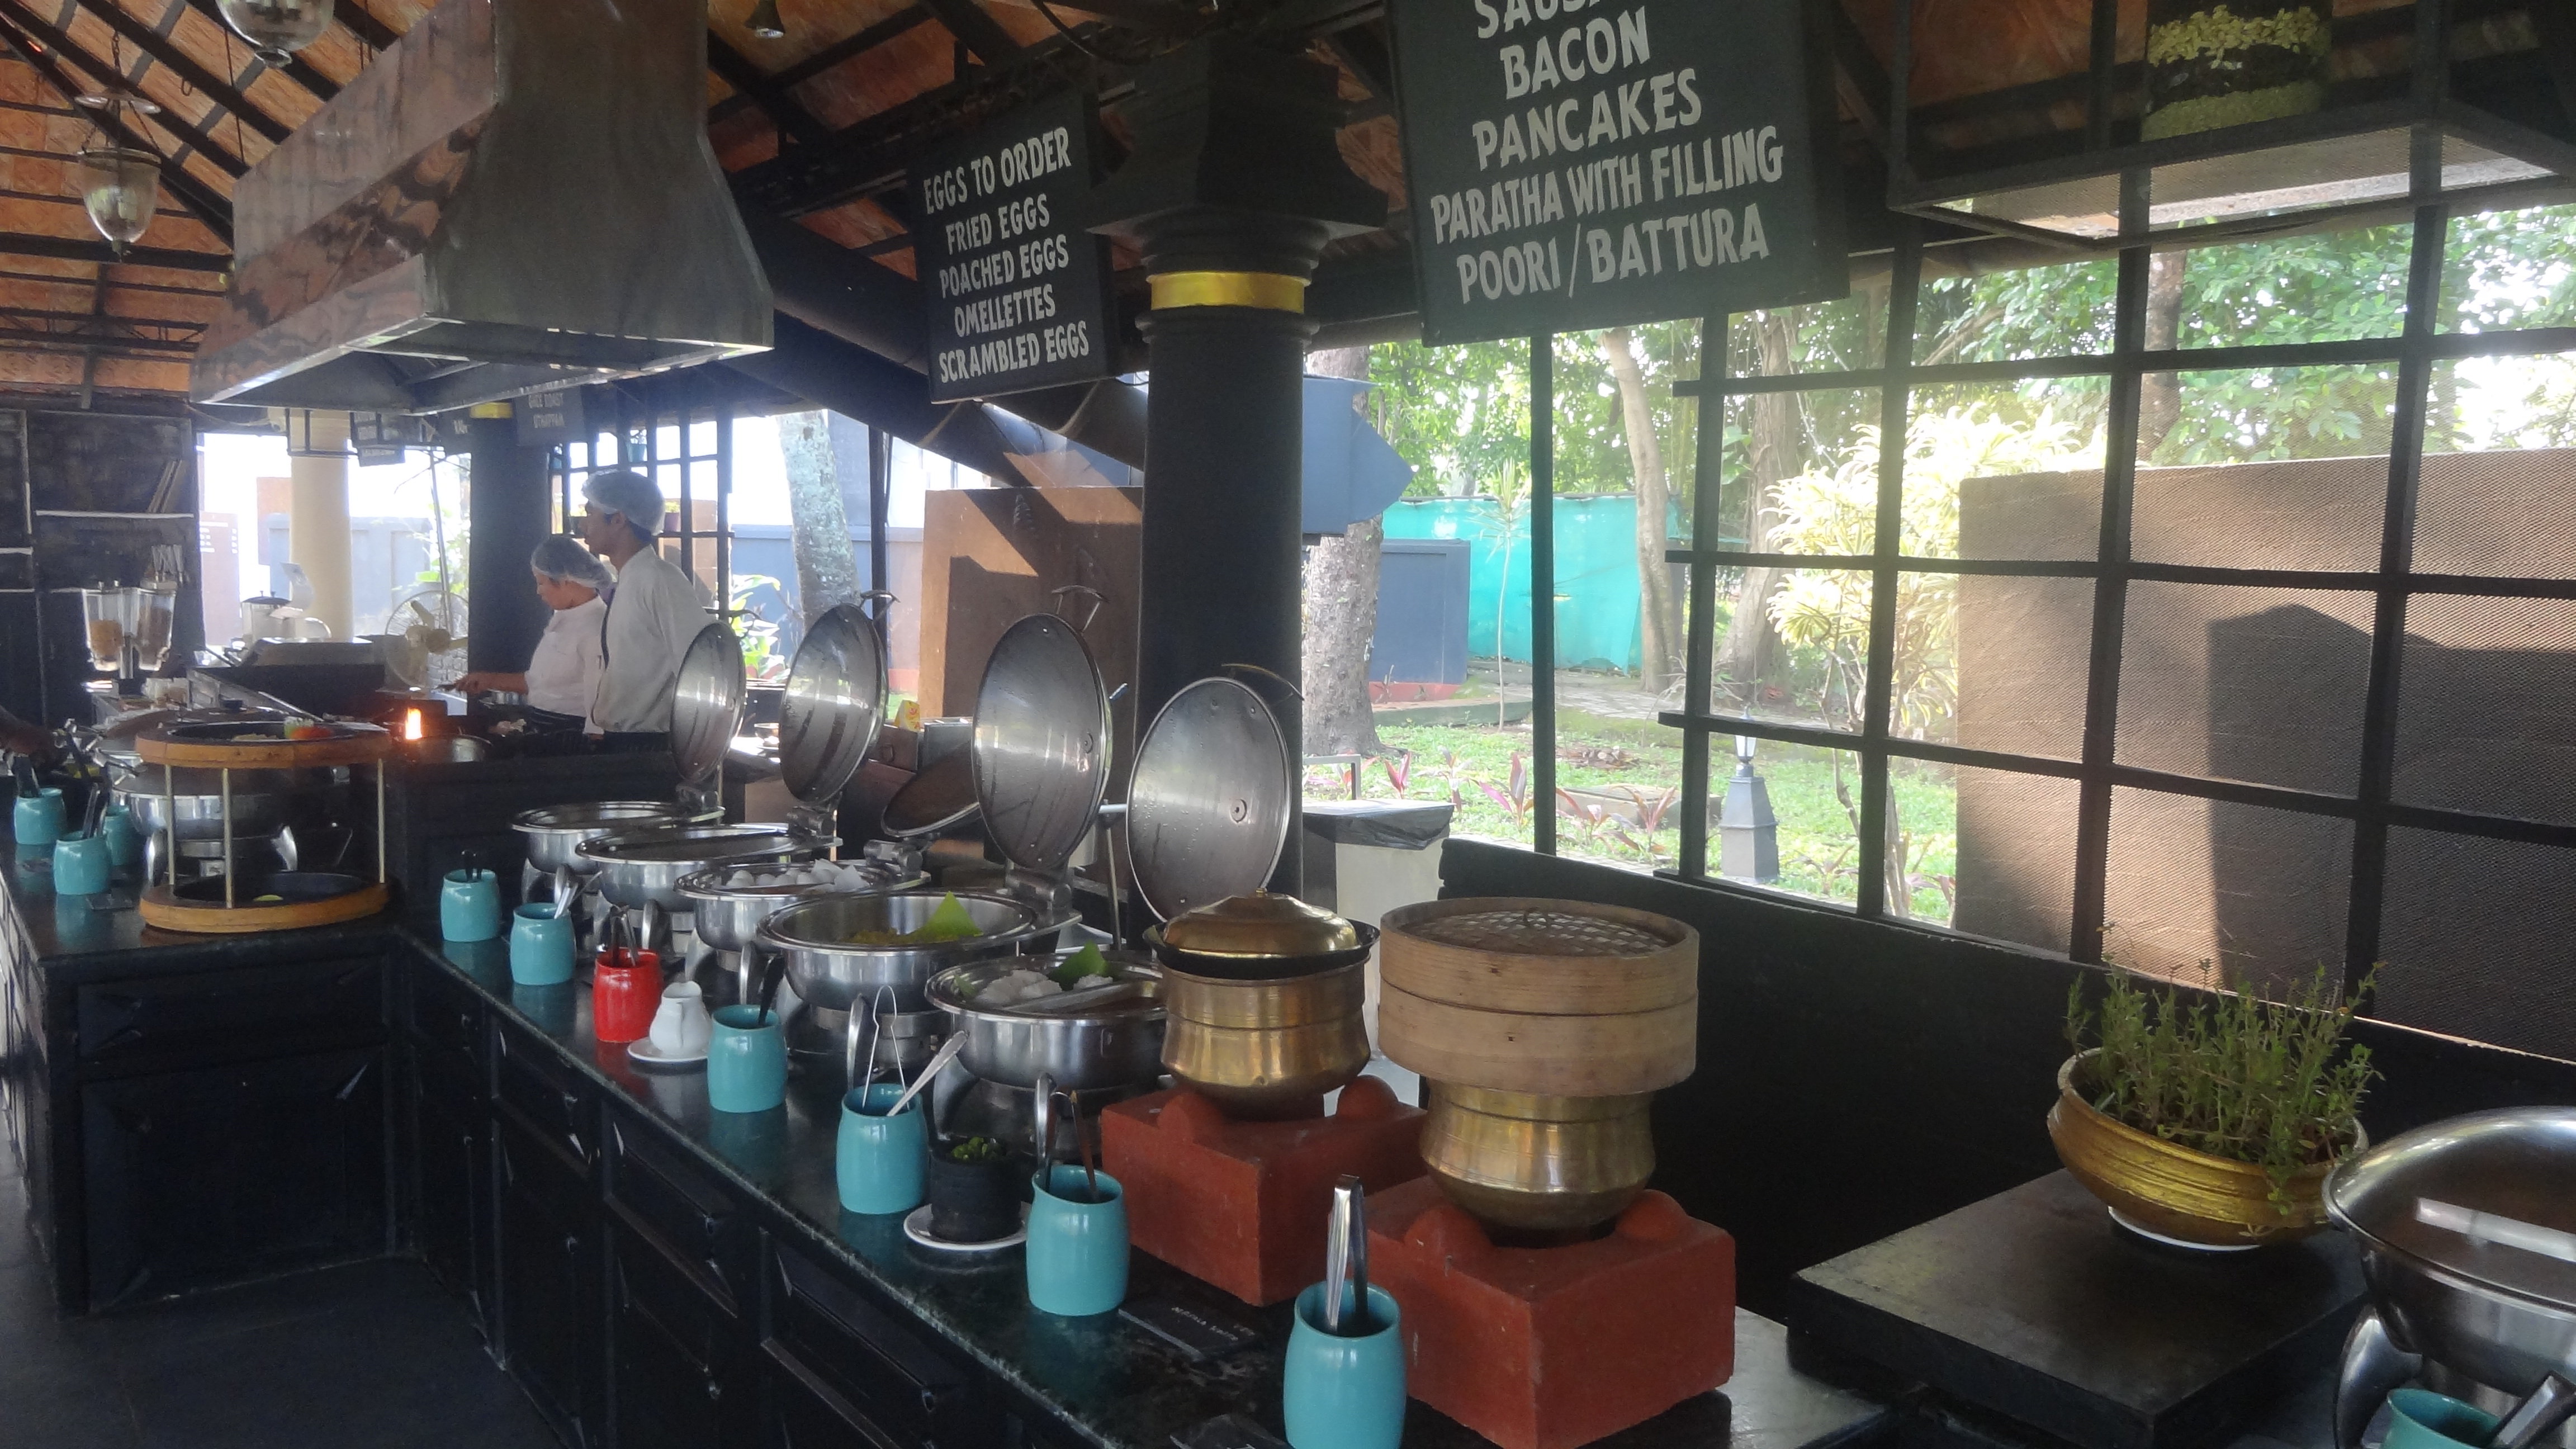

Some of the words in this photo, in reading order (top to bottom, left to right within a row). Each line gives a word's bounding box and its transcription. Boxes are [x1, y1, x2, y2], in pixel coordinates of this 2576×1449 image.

[1500, 6, 1650, 100] BACON
[1472, 68, 1702, 171] PANCAKES
[924, 167, 967, 214] EGGS
[970, 155, 996, 197] TO
[1000, 126, 1072, 187] ORDER
[1431, 171, 1565, 244] PARATHA
[1566, 153, 1642, 217] WITH
[1650, 125, 1783, 202] FILLING
[939, 250, 1015, 299] POACHED
[1019, 234, 1069, 279] EGGS
[946, 213, 992, 255] FRIED
[998, 193, 1050, 239] EGGS
[1456, 236, 1561, 305] POORI
[1586, 203, 1770, 283] BATTURA
[939, 333, 1040, 383] SCRAMBLED
[1044, 320, 1090, 363] EGGS
[954, 283, 1055, 338] OMELLETTES
